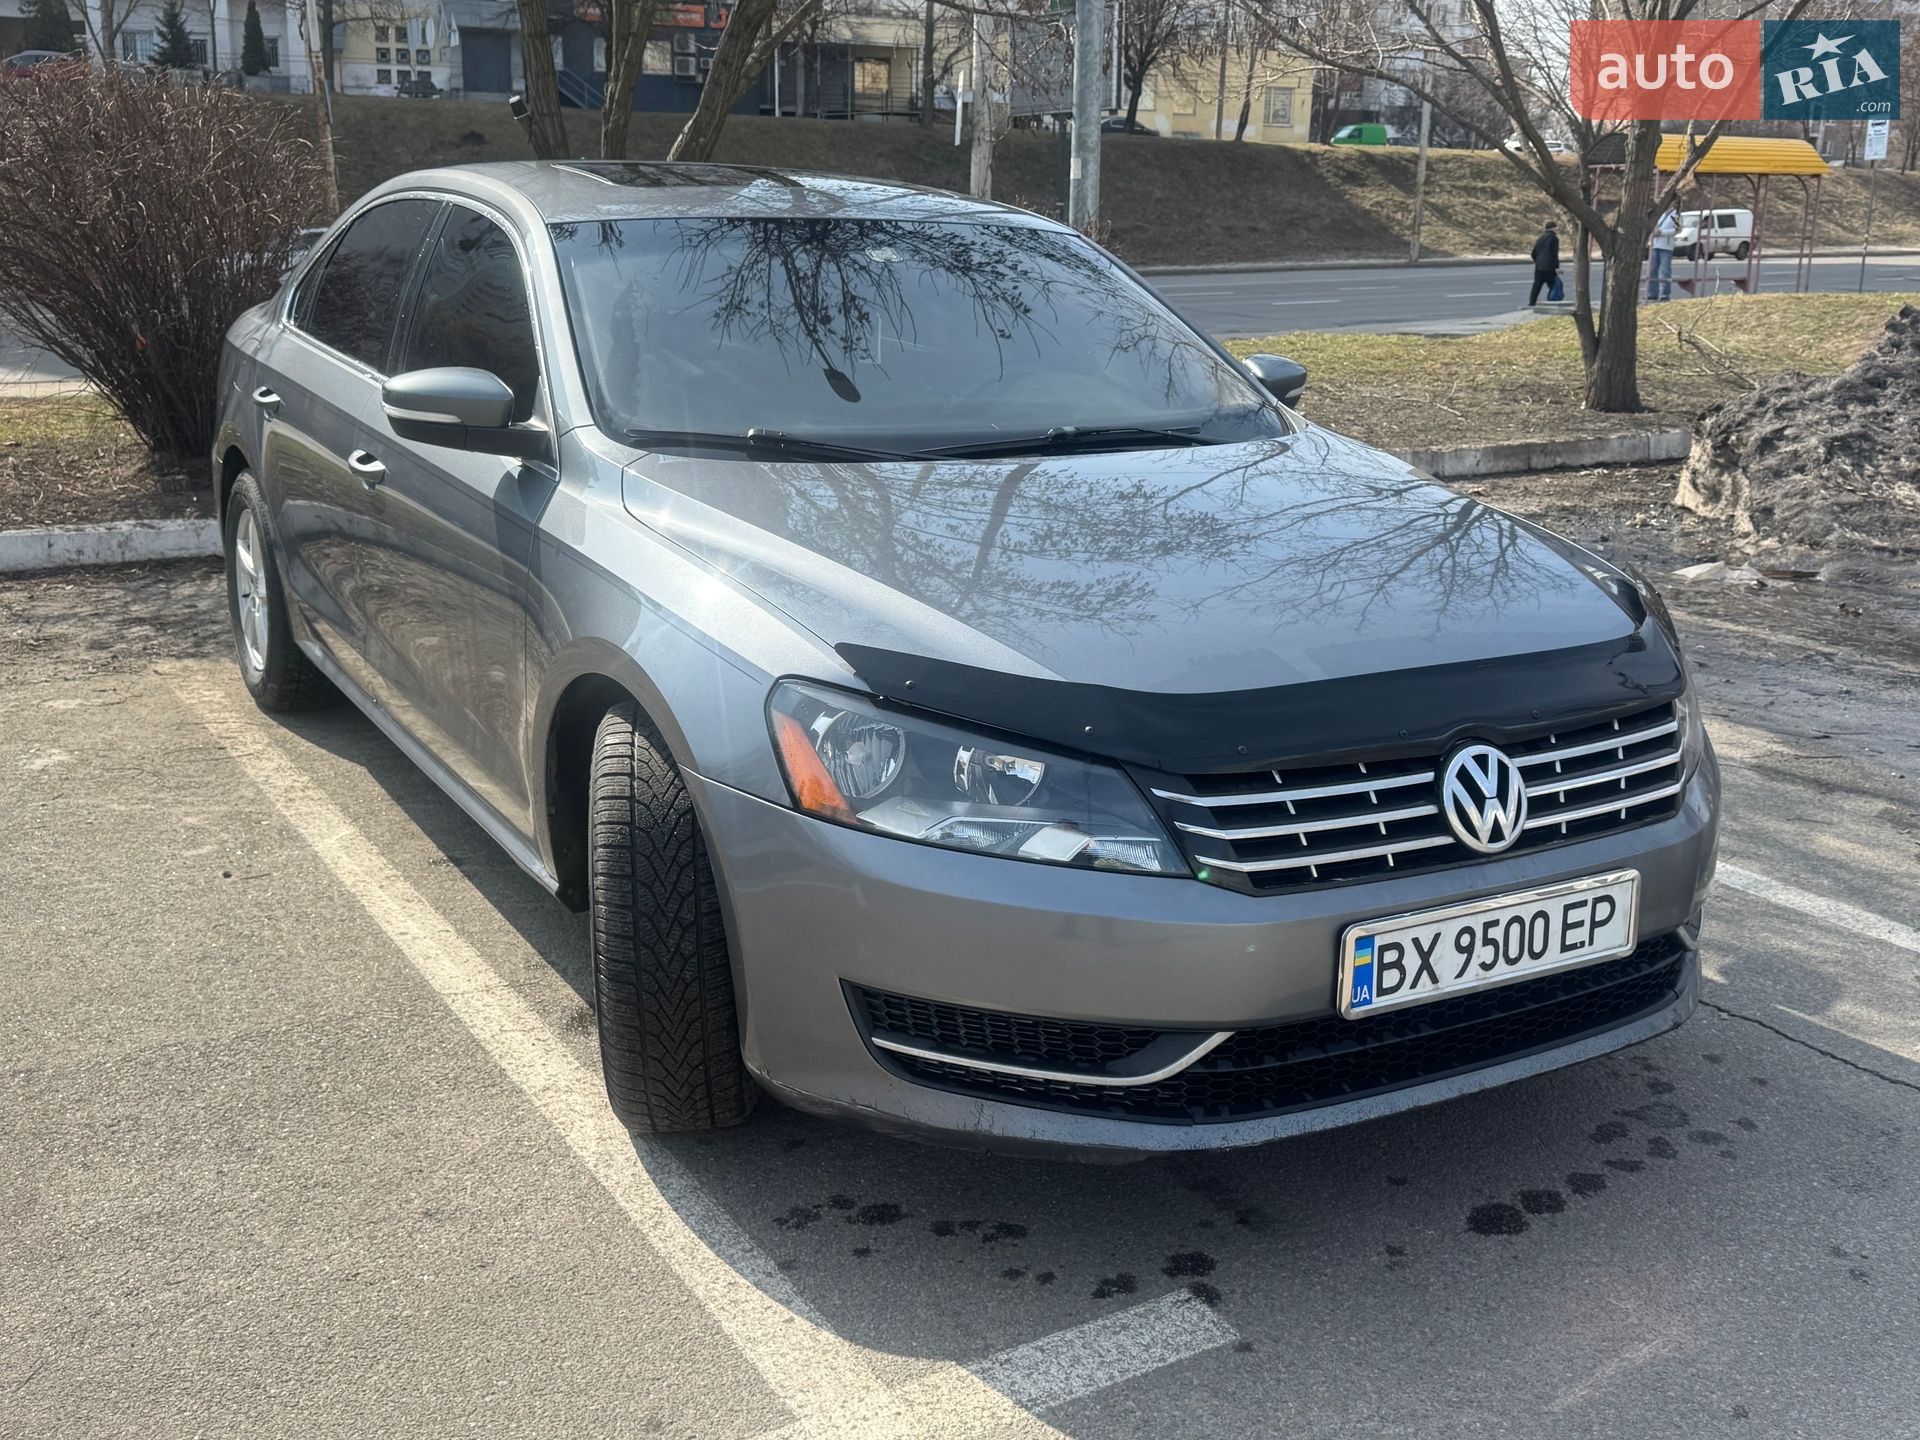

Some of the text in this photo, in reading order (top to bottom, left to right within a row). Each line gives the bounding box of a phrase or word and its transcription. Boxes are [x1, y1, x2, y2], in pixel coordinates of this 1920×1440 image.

[1376, 894, 1616, 998] BX 9500 EP
[1352, 985, 1370, 1003] UA
